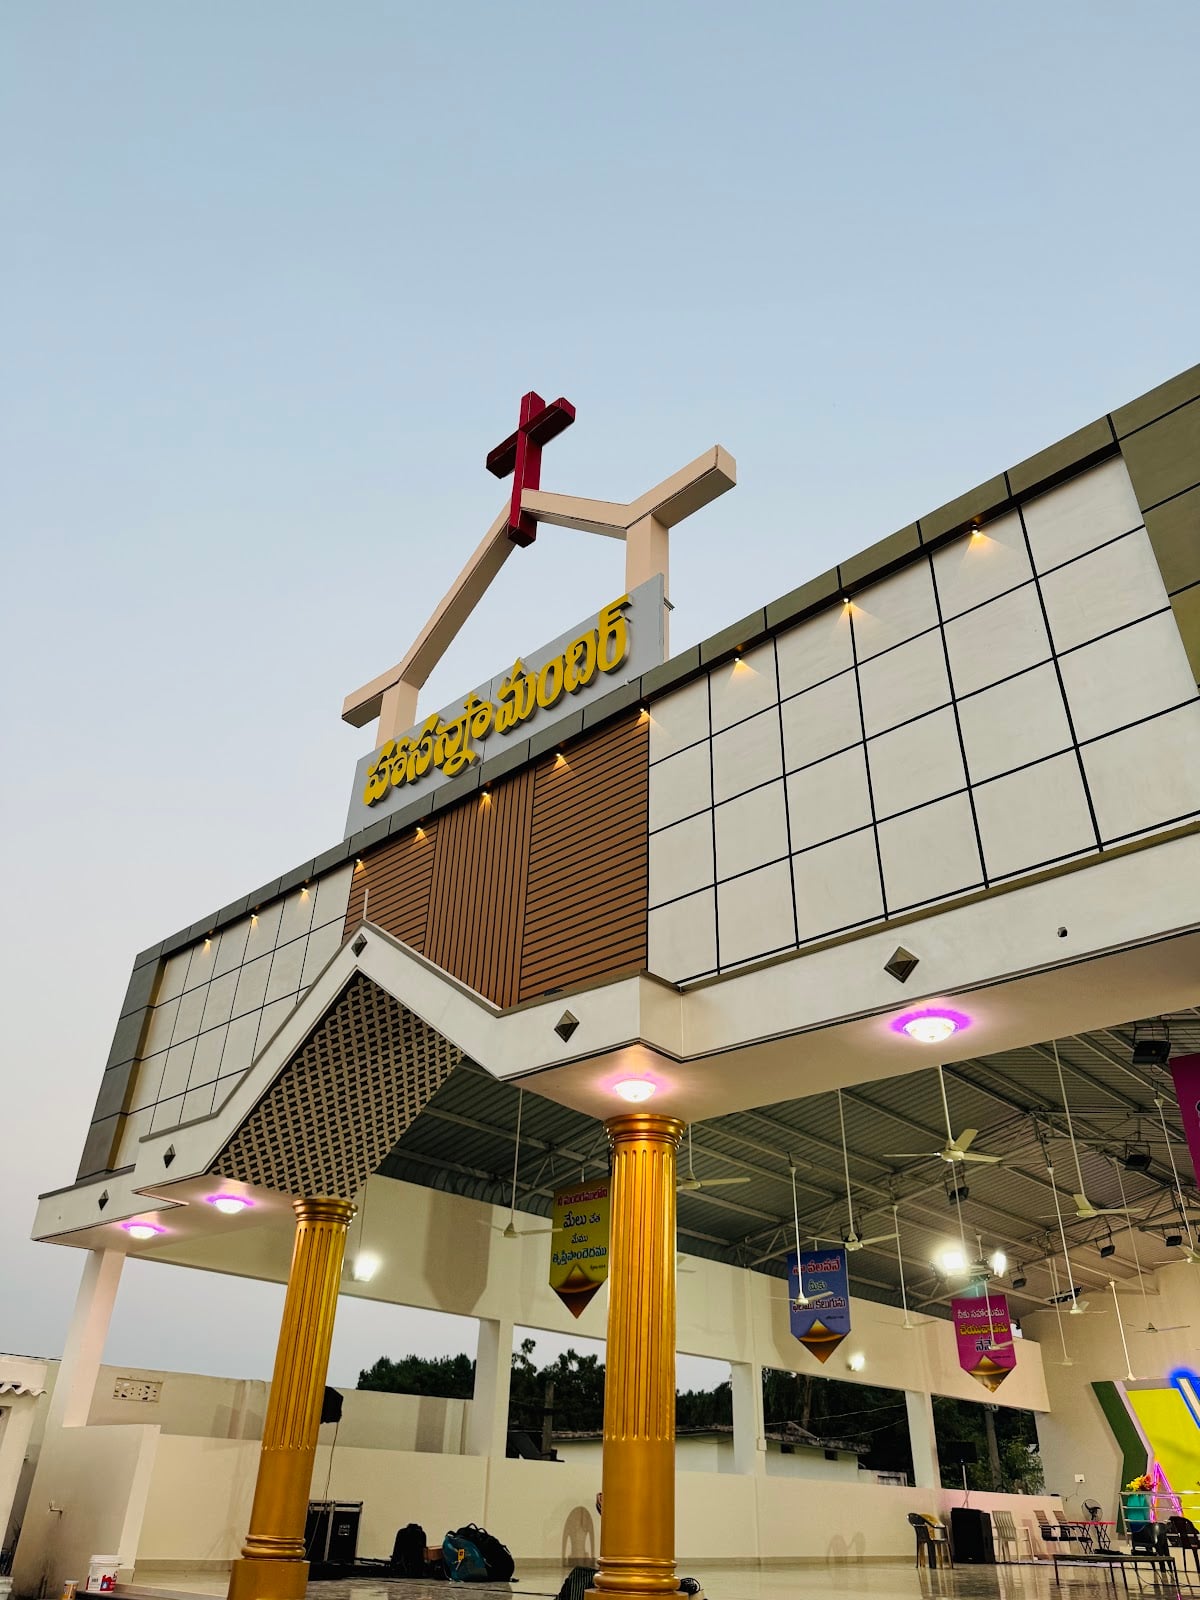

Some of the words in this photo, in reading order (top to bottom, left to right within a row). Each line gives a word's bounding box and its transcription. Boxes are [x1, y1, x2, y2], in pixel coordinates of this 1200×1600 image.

[363, 692, 494, 806] హోసన్నా
[495, 593, 631, 735] మందిర్
[563, 1210, 587, 1228] మేలు
